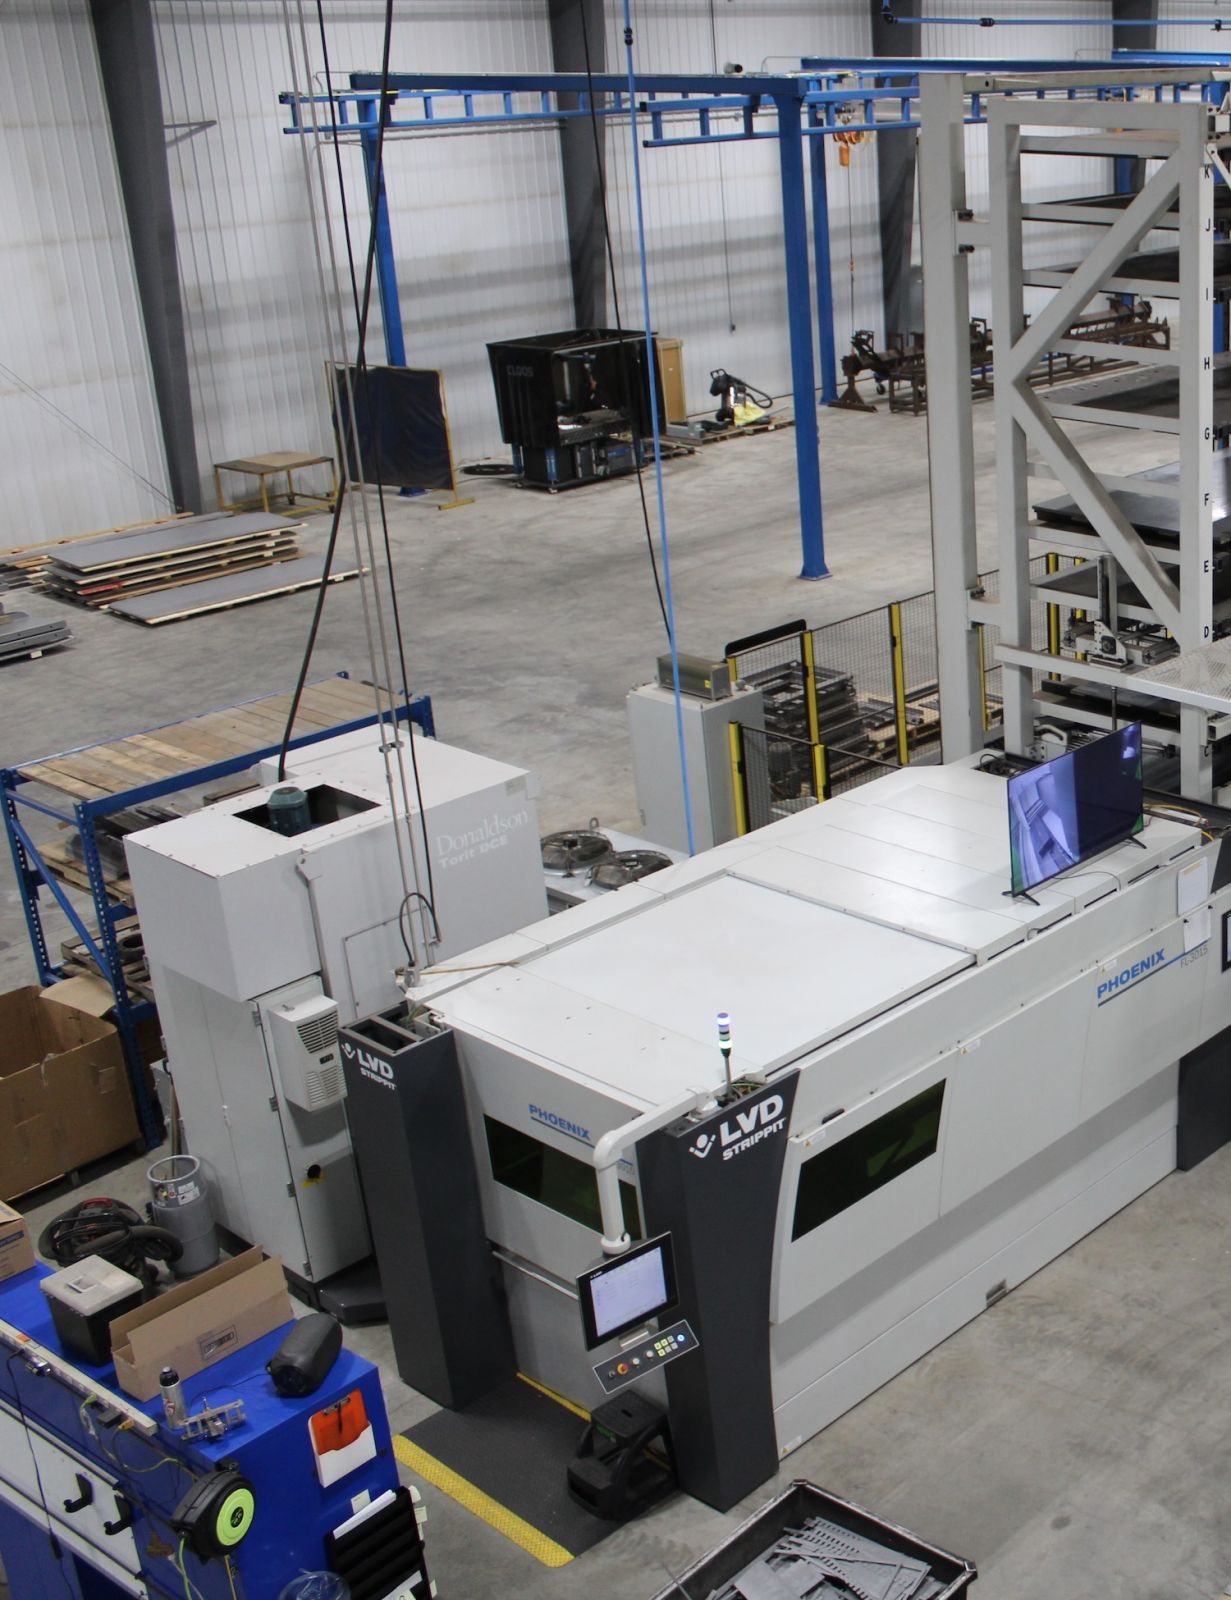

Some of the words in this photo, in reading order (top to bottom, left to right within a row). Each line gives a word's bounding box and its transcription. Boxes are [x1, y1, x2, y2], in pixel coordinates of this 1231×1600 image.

[1204, 164, 1210, 178] K
[1205, 218, 1211, 231] J
[1204, 357, 1210, 370] H
[1204, 427, 1210, 440] G
[1204, 493, 1210, 506] F
[1204, 560, 1209, 573] E
[1204, 626, 1210, 639] D
[436, 811, 528, 857] Donaldson
[438, 849, 475, 870] Torit
[479, 834, 509, 854] DCE
[1180, 948, 1208, 968] FL-3015
[1097, 948, 1165, 999] PHOENIX
[356, 1048, 394, 1080] LVD
[360, 1067, 397, 1091] STRIPPIT
[528, 1103, 590, 1141] PHOENIX
[719, 1094, 784, 1147] LVD
[722, 1116, 787, 1161] STRIPPIT
